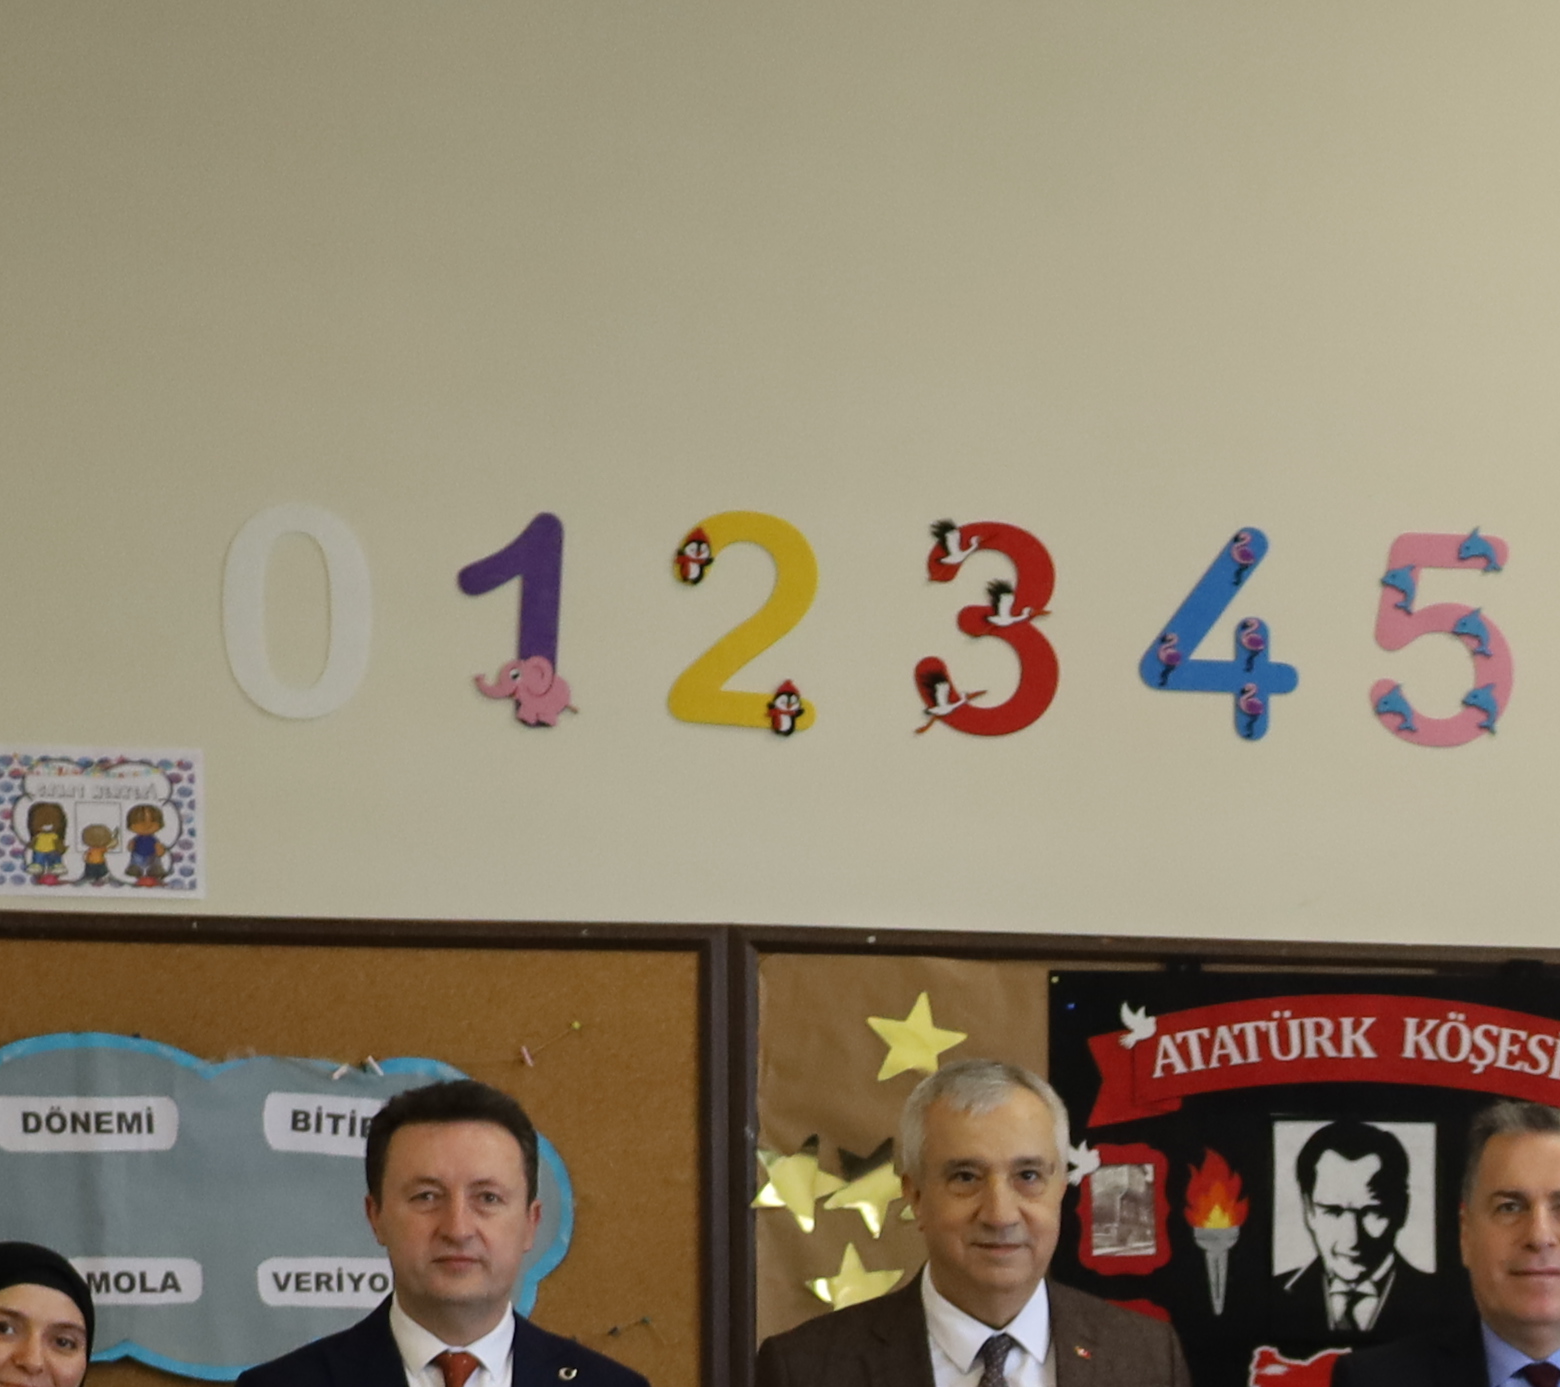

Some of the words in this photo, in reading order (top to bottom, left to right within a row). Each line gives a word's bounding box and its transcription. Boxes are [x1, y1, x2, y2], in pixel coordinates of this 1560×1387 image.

[222, 502, 372, 720] 0
[457, 511, 578, 728] 1
[667, 510, 817, 732] 2
[914, 519, 1059, 736] 3
[1139, 526, 1299, 741] 4
[1369, 530, 1513, 749] 5
[1152, 1010, 1378, 1078] ATATÜRK
[21, 1105, 155, 1135] DÖNEMİ
[89, 1271, 181, 1294] MOLA
